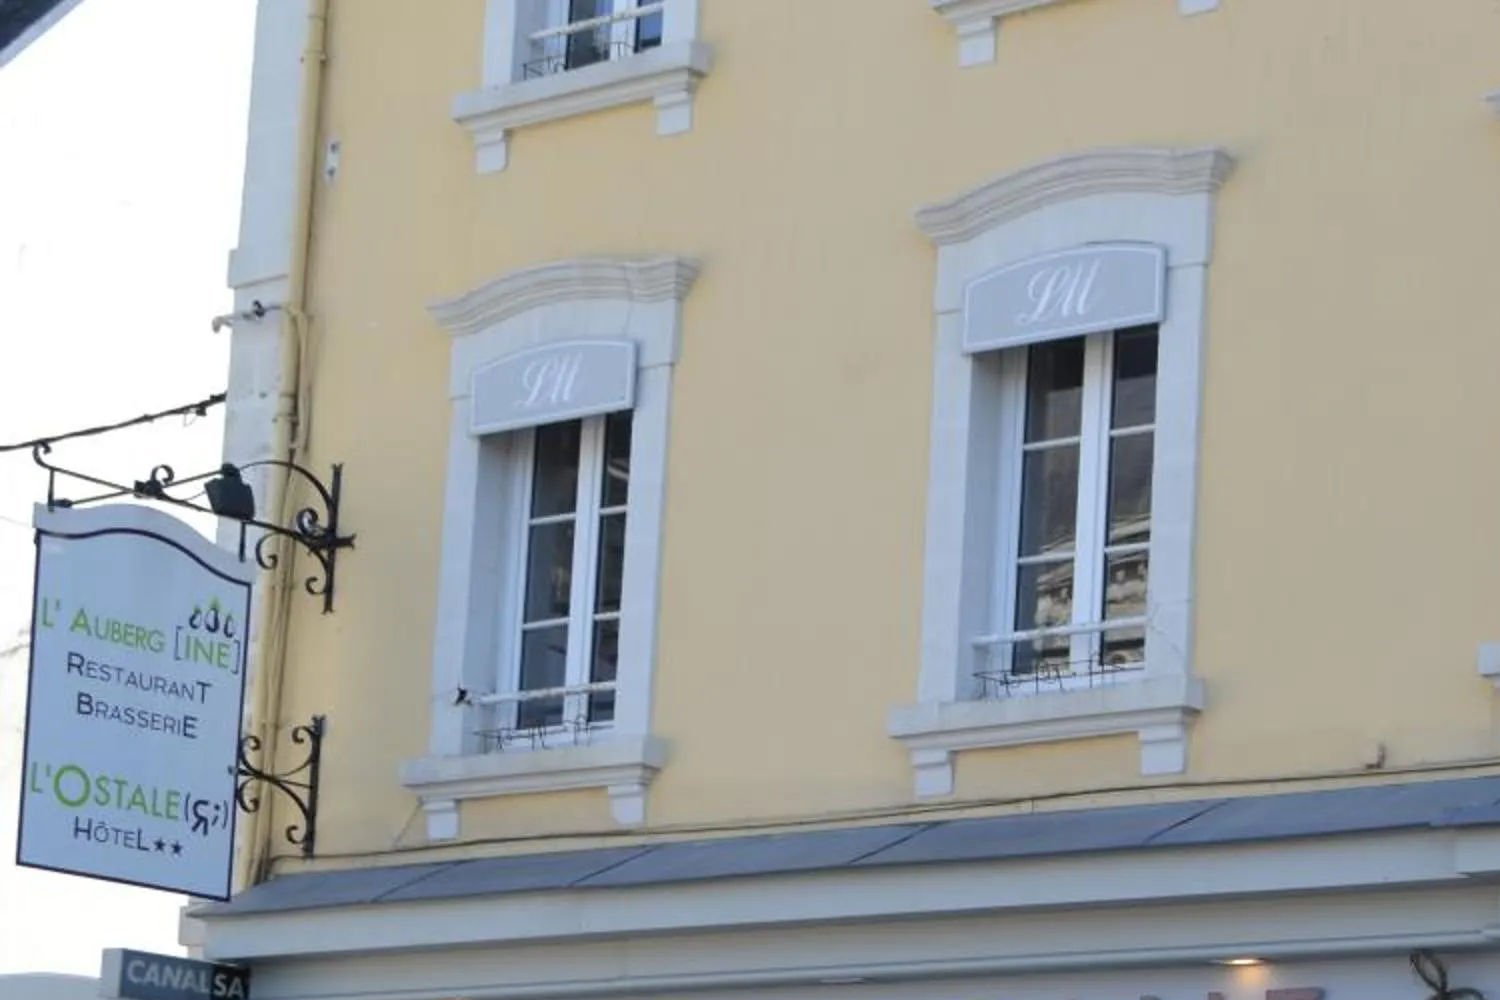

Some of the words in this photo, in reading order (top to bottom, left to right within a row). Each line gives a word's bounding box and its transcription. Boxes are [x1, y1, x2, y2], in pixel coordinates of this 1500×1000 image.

[66, 653, 212, 704] RESTAURANT
[77, 692, 199, 739] BRASSERIE
[126, 959, 246, 999] CANALSA
